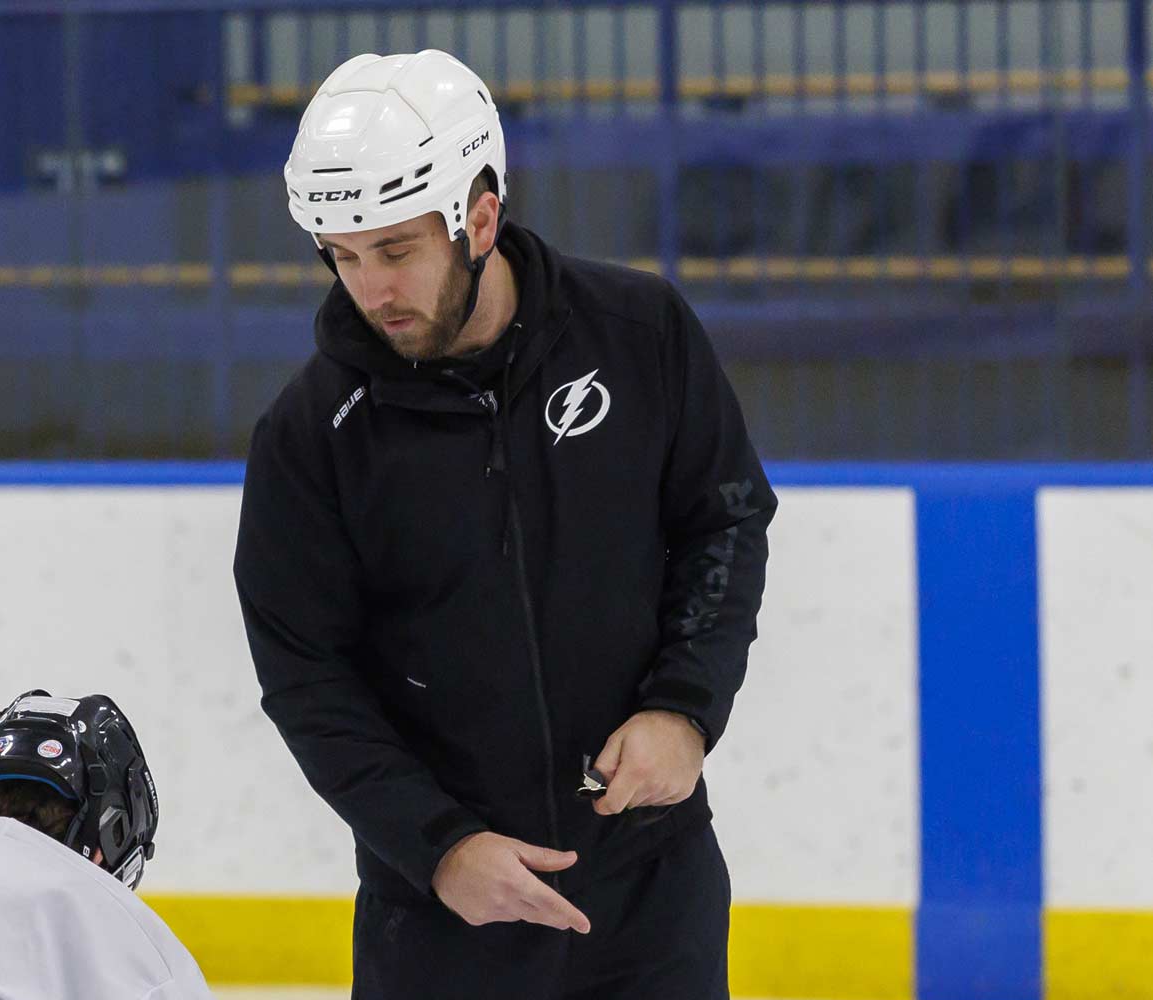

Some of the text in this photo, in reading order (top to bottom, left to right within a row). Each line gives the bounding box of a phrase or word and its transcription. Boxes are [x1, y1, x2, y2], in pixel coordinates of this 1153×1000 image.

[461, 130, 490, 158] CCM
[307, 188, 363, 203] CCM
[332, 386, 366, 429] BAUE
